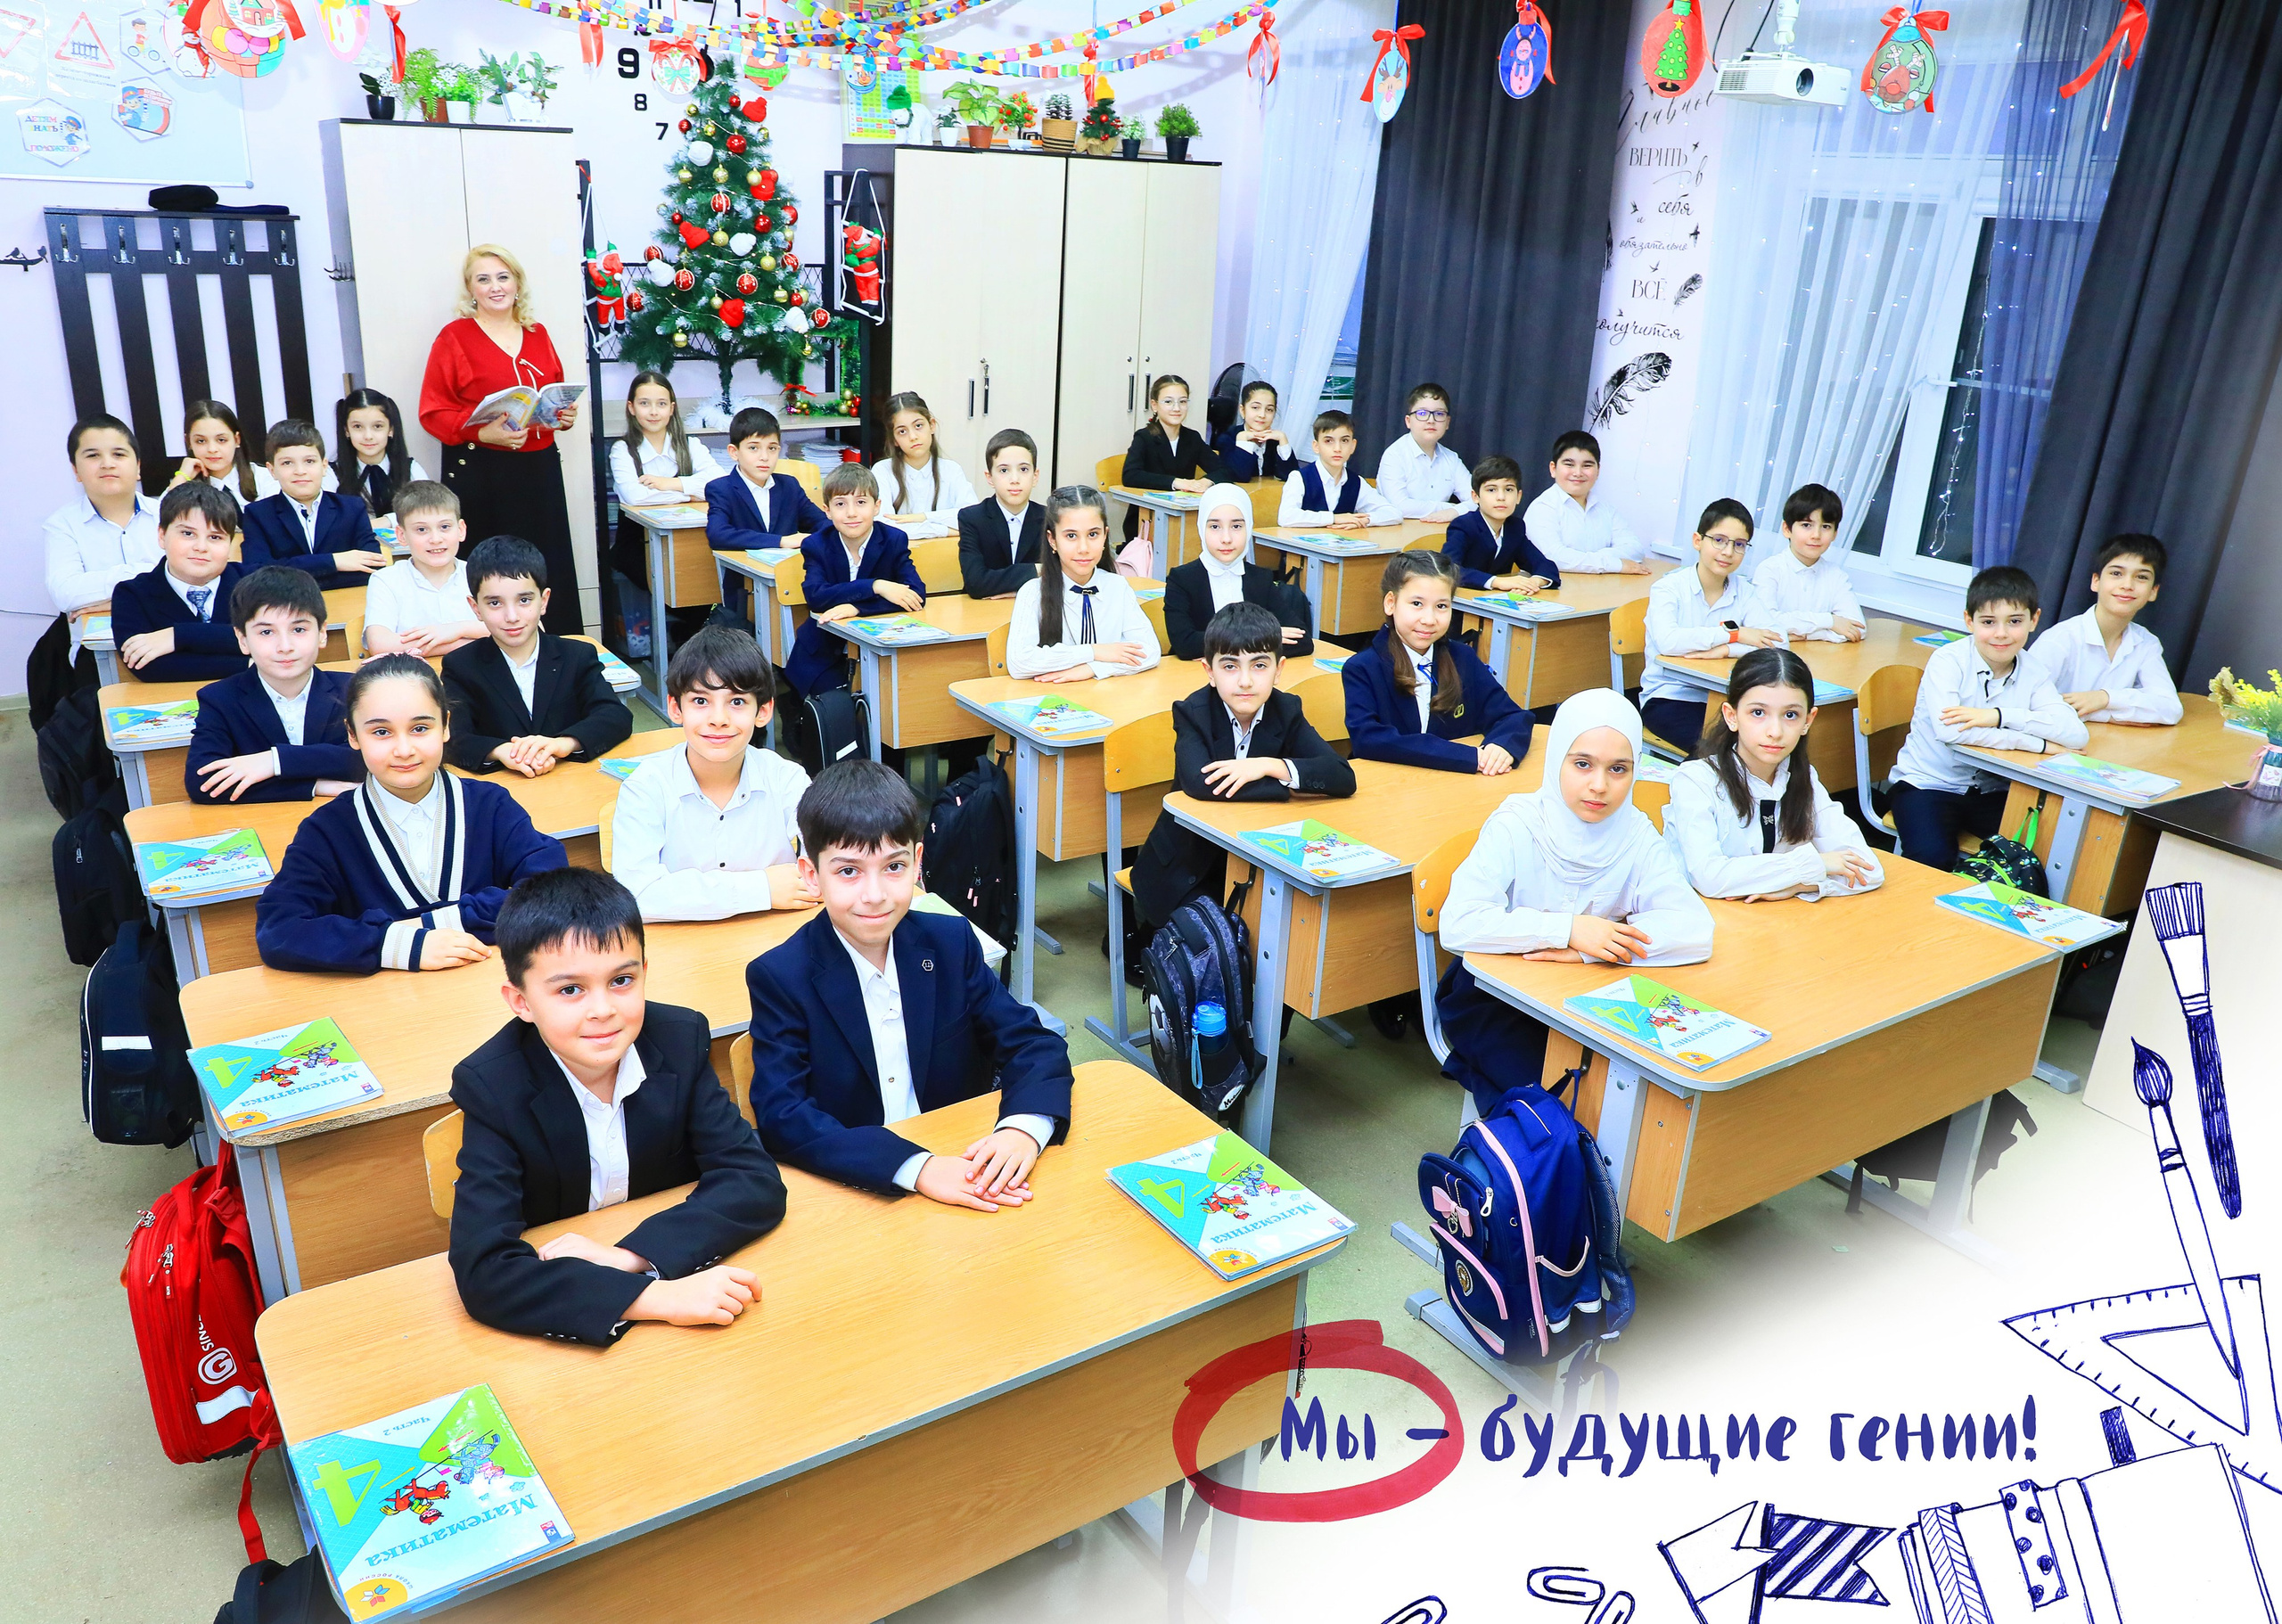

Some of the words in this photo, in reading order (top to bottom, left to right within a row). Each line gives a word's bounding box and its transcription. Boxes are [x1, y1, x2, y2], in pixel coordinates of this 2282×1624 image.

[618, 47, 639, 78] 9
[634, 93, 647, 111] 8
[24, 115, 57, 123] ДЕТЯМ
[655, 122, 669, 140] 7
[1629, 148, 1687, 167] ВЕРИТЬ
[1658, 193, 1694, 216] себя
[1620, 236, 1687, 258] обязательно
[1256, 838, 1290, 856] 4
[147, 850, 185, 871] 4
[1958, 902, 2006, 922] 4
[1588, 1005, 1639, 1033] 4
[1669, 1018, 1736, 1048] Математика
[203, 1055, 252, 1089] 4
[239, 1070, 360, 1108] Математика
[1137, 1175, 1186, 1219] 4
[1210, 1202, 1318, 1245] Математика
[383, 1429, 391, 1437] 2
[392, 1416, 431, 1432] Часть
[312, 1458, 382, 1528] 4
[365, 1493, 538, 1568] Математика
